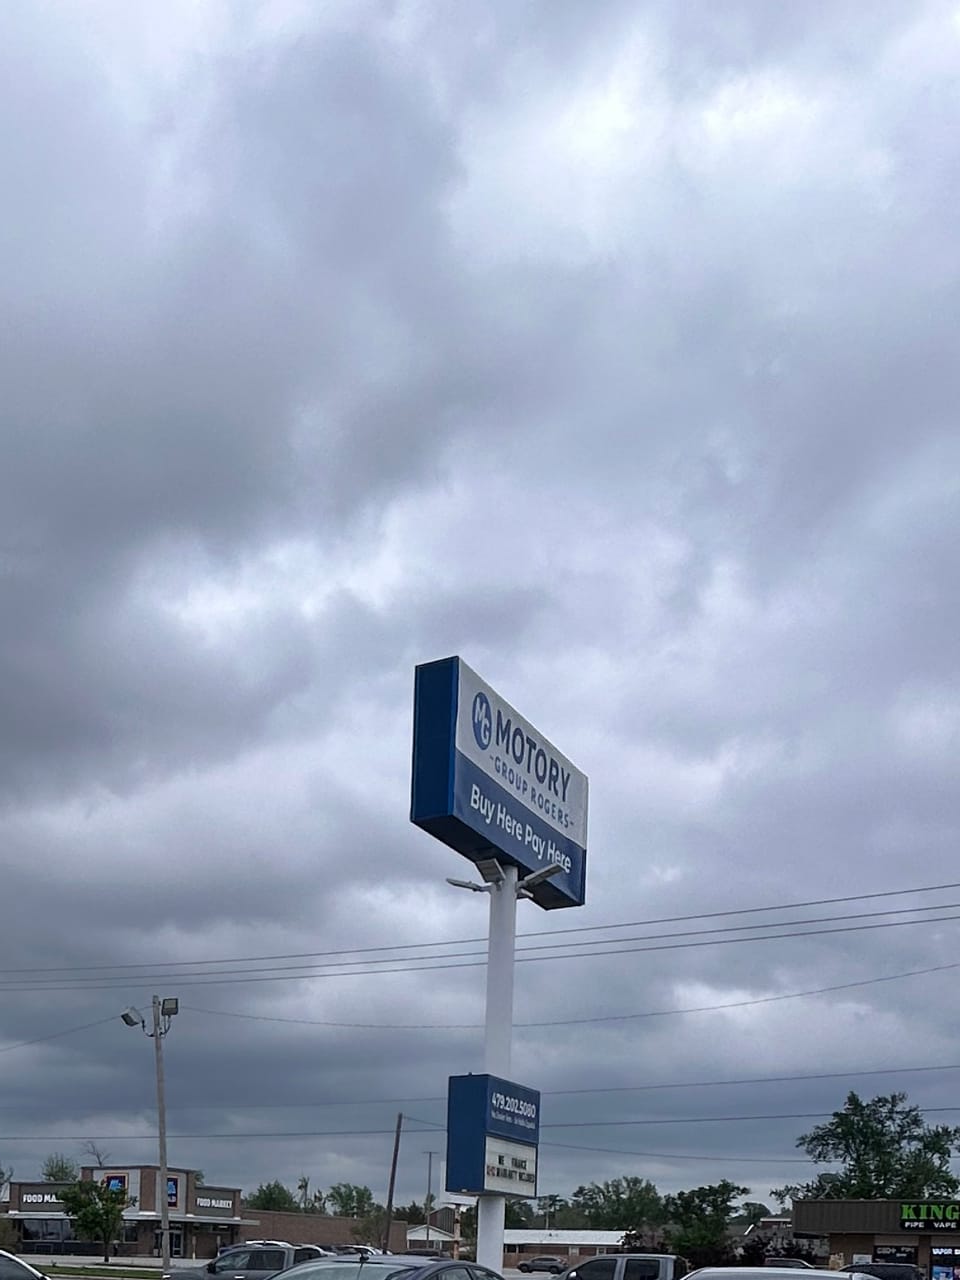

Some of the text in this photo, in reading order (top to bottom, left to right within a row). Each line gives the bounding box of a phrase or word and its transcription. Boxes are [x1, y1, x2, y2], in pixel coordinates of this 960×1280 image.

[495, 709, 571, 803] MOTORY
[470, 783, 572, 874] Buy Here Pay Here
[23, 1194, 43, 1202] FOOD
[933, 1221, 957, 1229] VAPE
